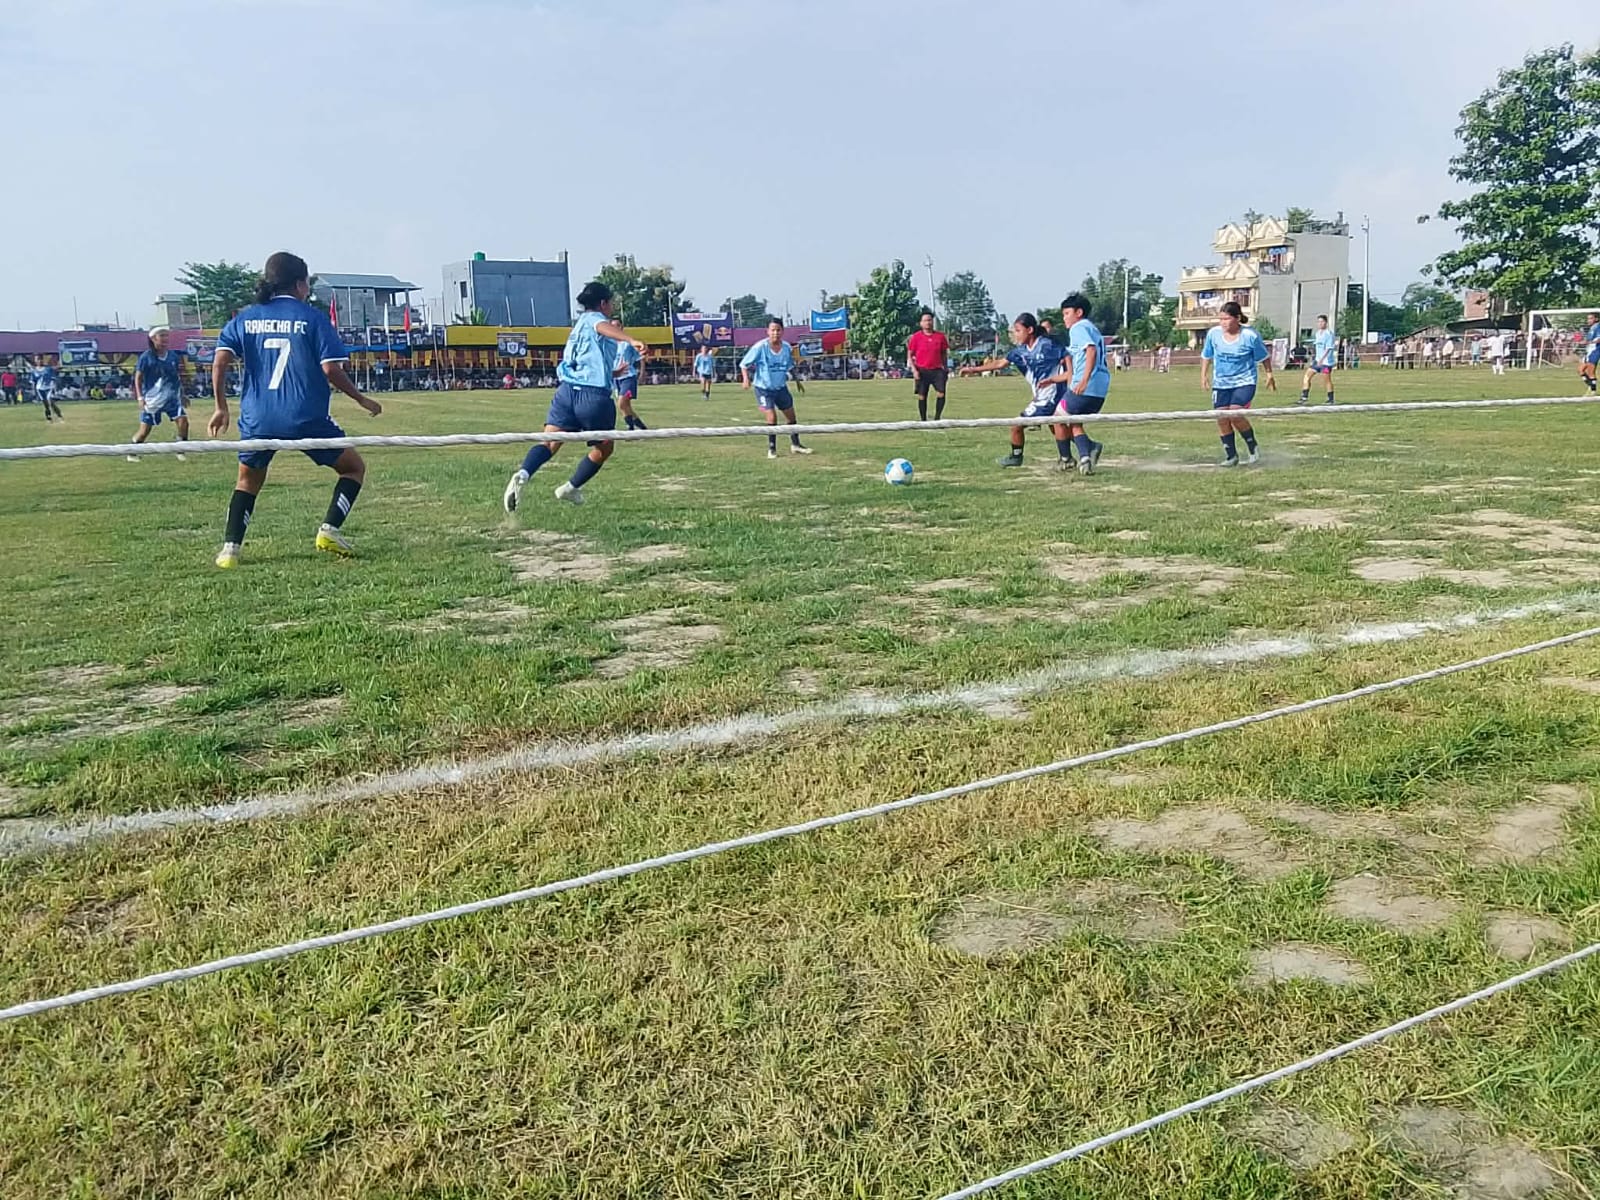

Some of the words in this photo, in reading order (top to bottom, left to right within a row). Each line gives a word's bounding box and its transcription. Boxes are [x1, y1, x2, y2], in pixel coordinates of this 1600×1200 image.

[244, 319, 291, 334] RANGCHA
[293, 320, 308, 335] FC
[264, 338, 291, 390] 7
